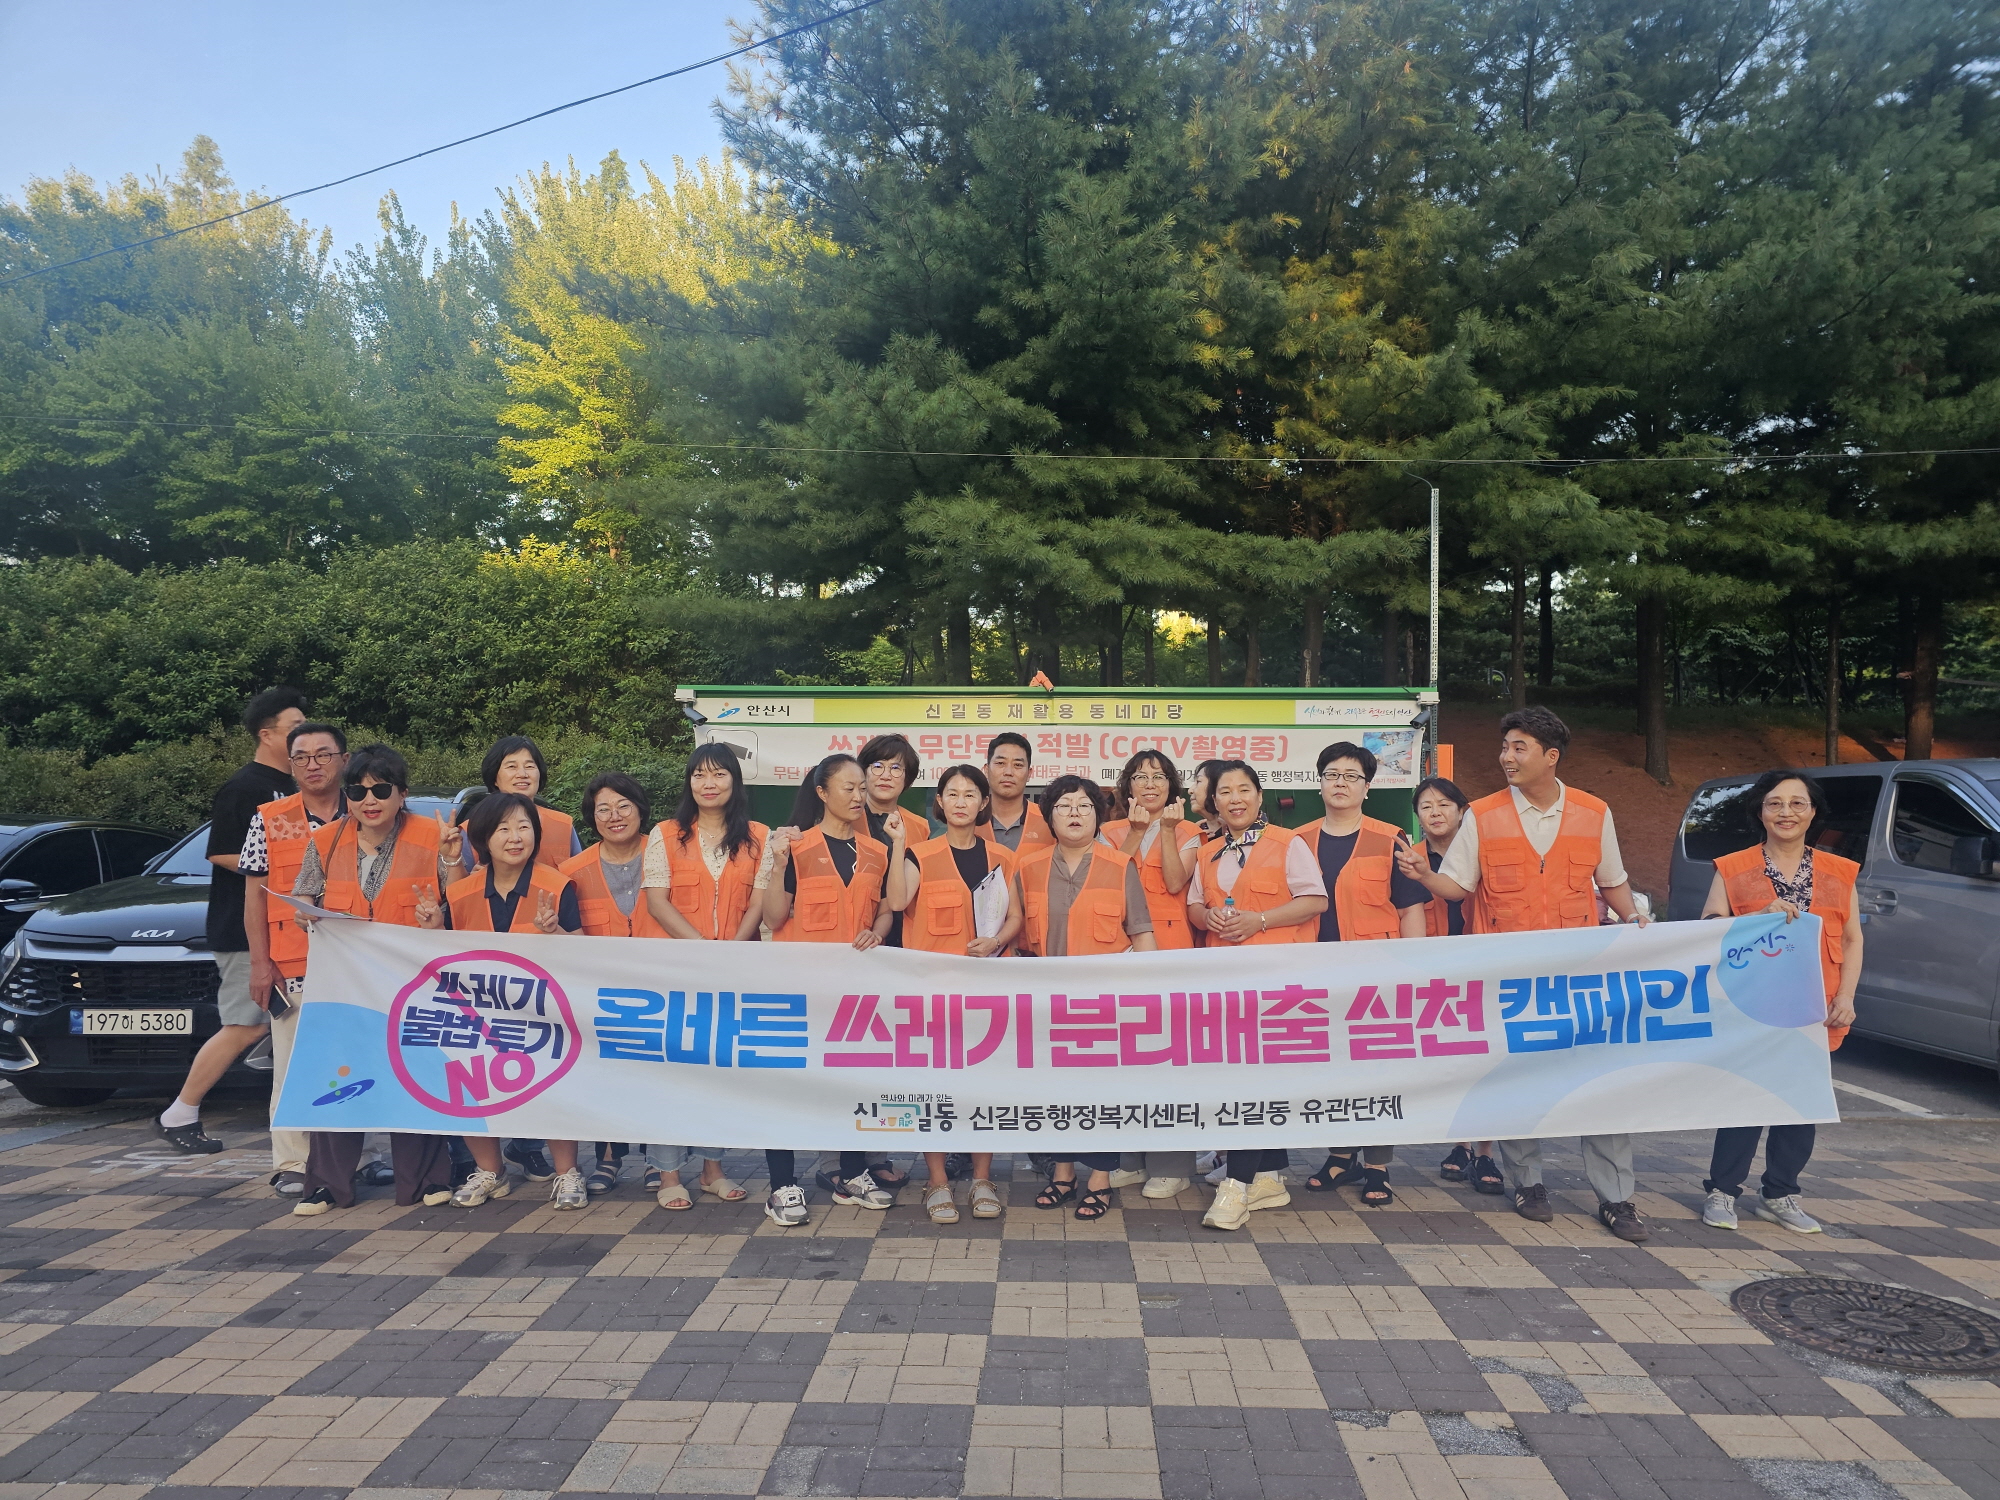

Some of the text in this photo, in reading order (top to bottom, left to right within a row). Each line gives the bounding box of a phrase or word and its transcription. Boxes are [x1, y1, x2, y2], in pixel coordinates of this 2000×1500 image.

[747, 704, 790, 717] 안산시
[925, 703, 1184, 720] 신길동 재활용 동네마당
[1036, 733, 1092, 759] 적발
[773, 766, 801, 780] 무단
[432, 971, 549, 1017] 쓰레기
[86, 1013, 187, 1031] 197하 5380
[594, 965, 1713, 1069] 올바른 쓰레기 분리배출 실천 캠페인
[444, 1051, 536, 1106] NO
[880, 1093, 953, 1103] 역사와 미래가 있는
[853, 1094, 1404, 1133] 신길동 신길동행정복지센터, 신길동 유관단체
